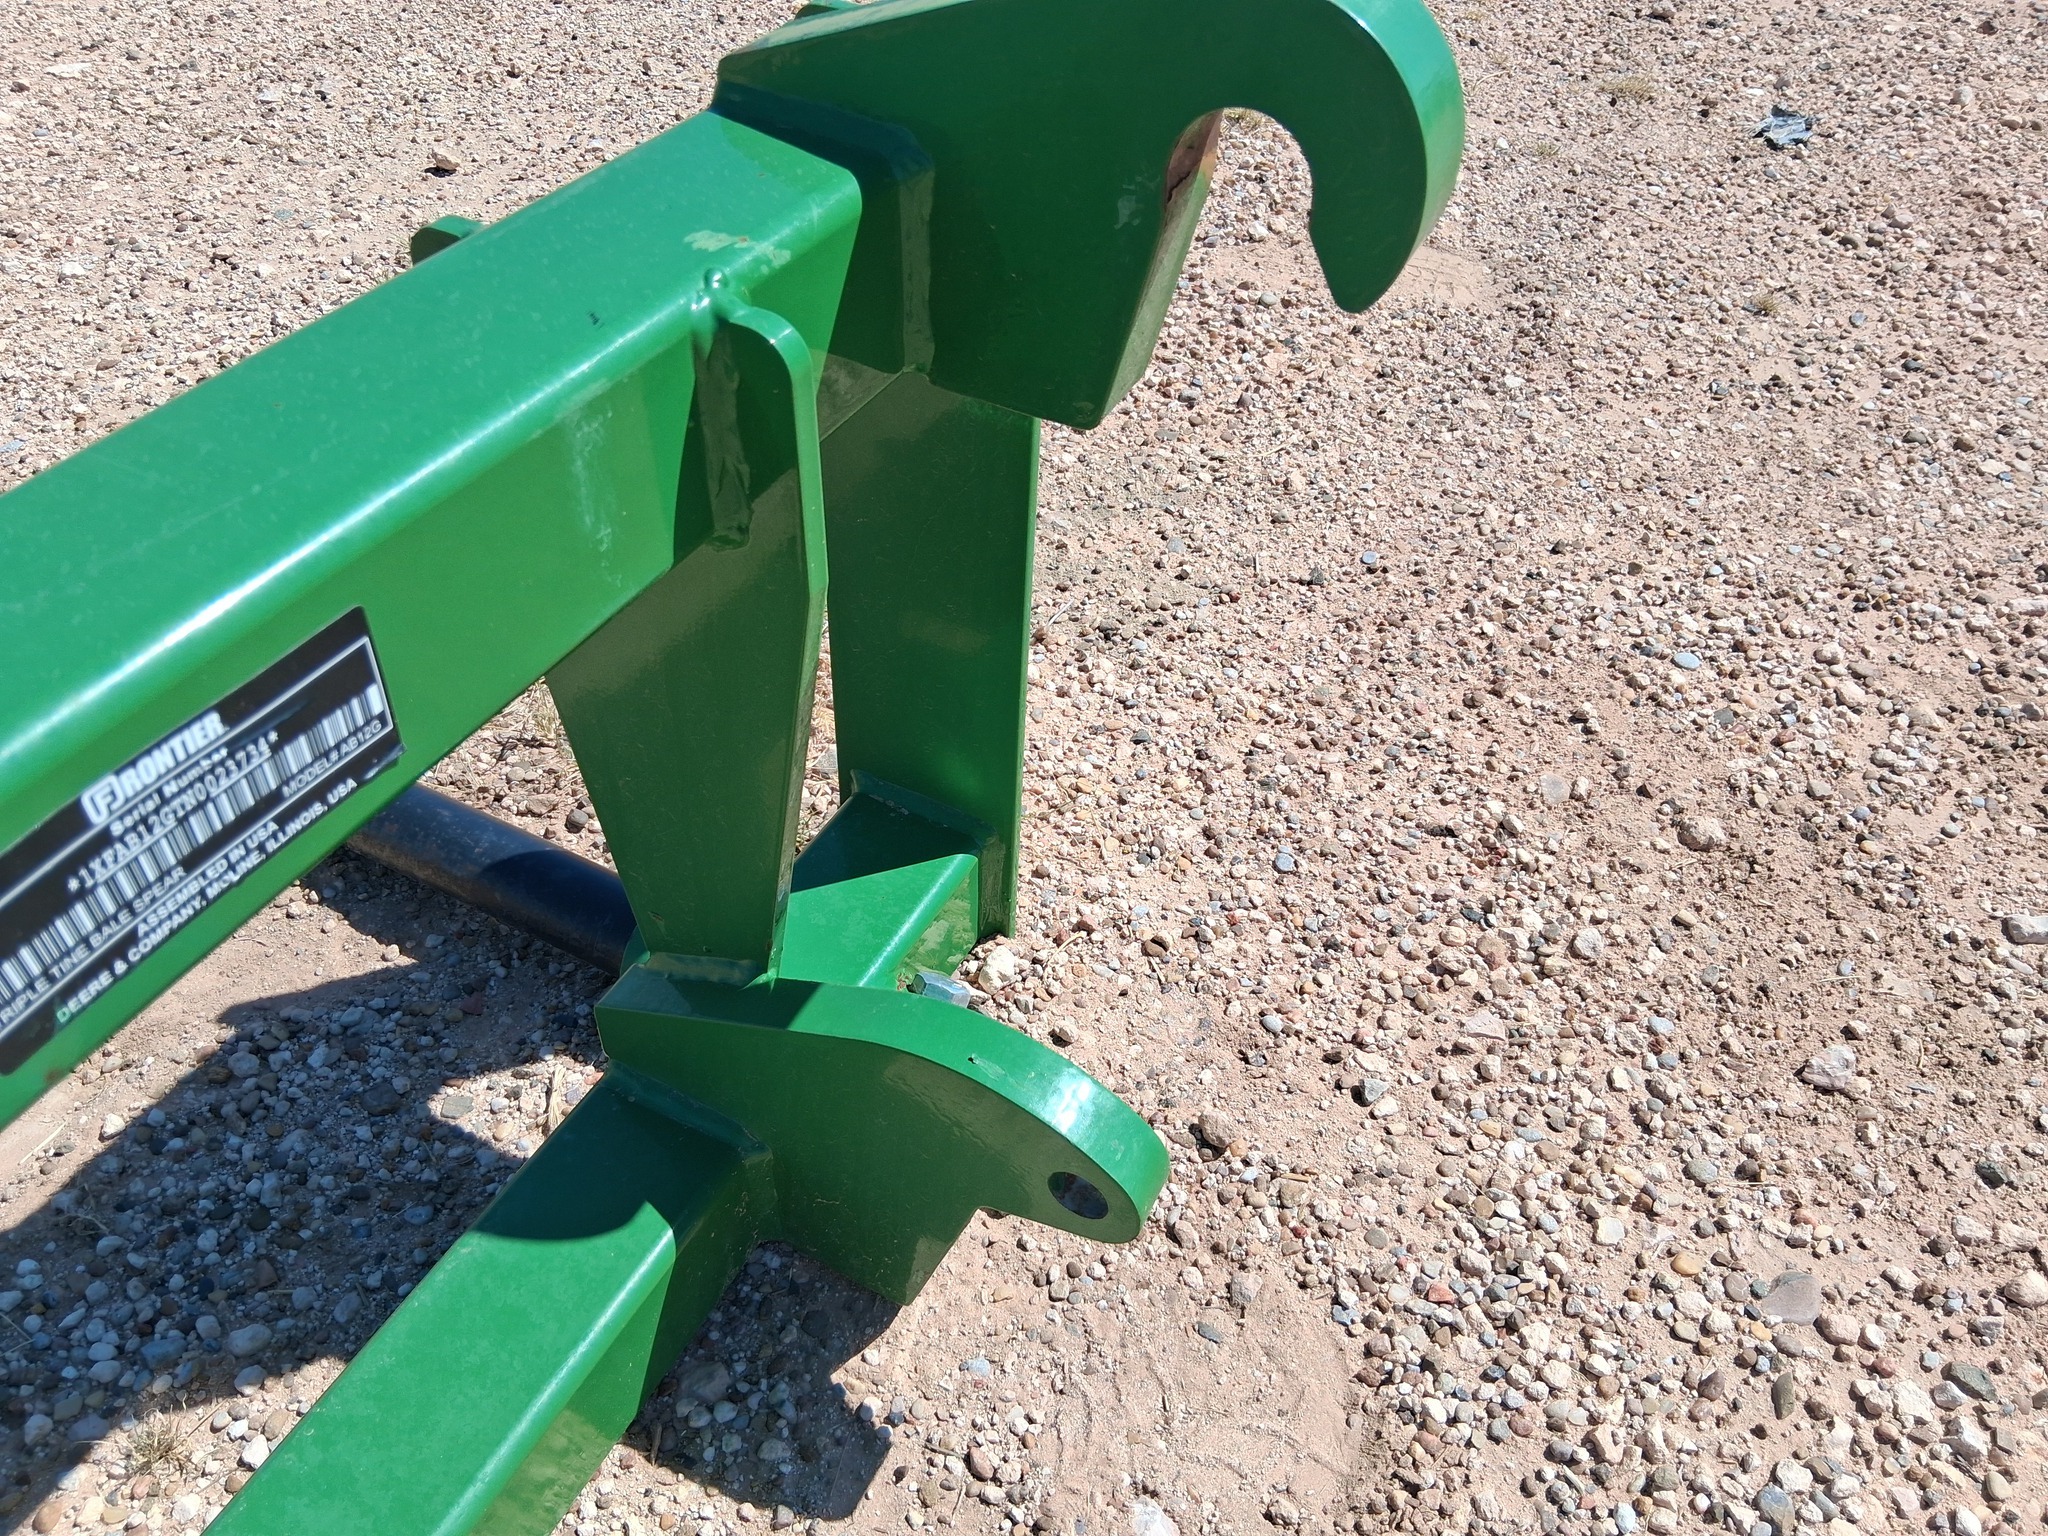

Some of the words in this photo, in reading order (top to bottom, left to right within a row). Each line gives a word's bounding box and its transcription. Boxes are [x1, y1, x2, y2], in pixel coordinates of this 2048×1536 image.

[110, 792, 161, 836] Serial
[162, 747, 228, 798] Number
[0, 976, 51, 1024] RIPLE
[49, 944, 90, 979] TINE
[89, 909, 134, 948] BALE
[132, 867, 187, 912] SPEAR
[57, 970, 114, 1023] DEERE
[113, 959, 129, 975] &
[205, 850, 266, 899] MOLINE,
[265, 801, 328, 853] ILLINOIS,
[326, 777, 358, 804] USA
[137, 858, 229, 937] ASSEMBLED
[228, 844, 247, 864] IN
[246, 820, 279, 849] USA
